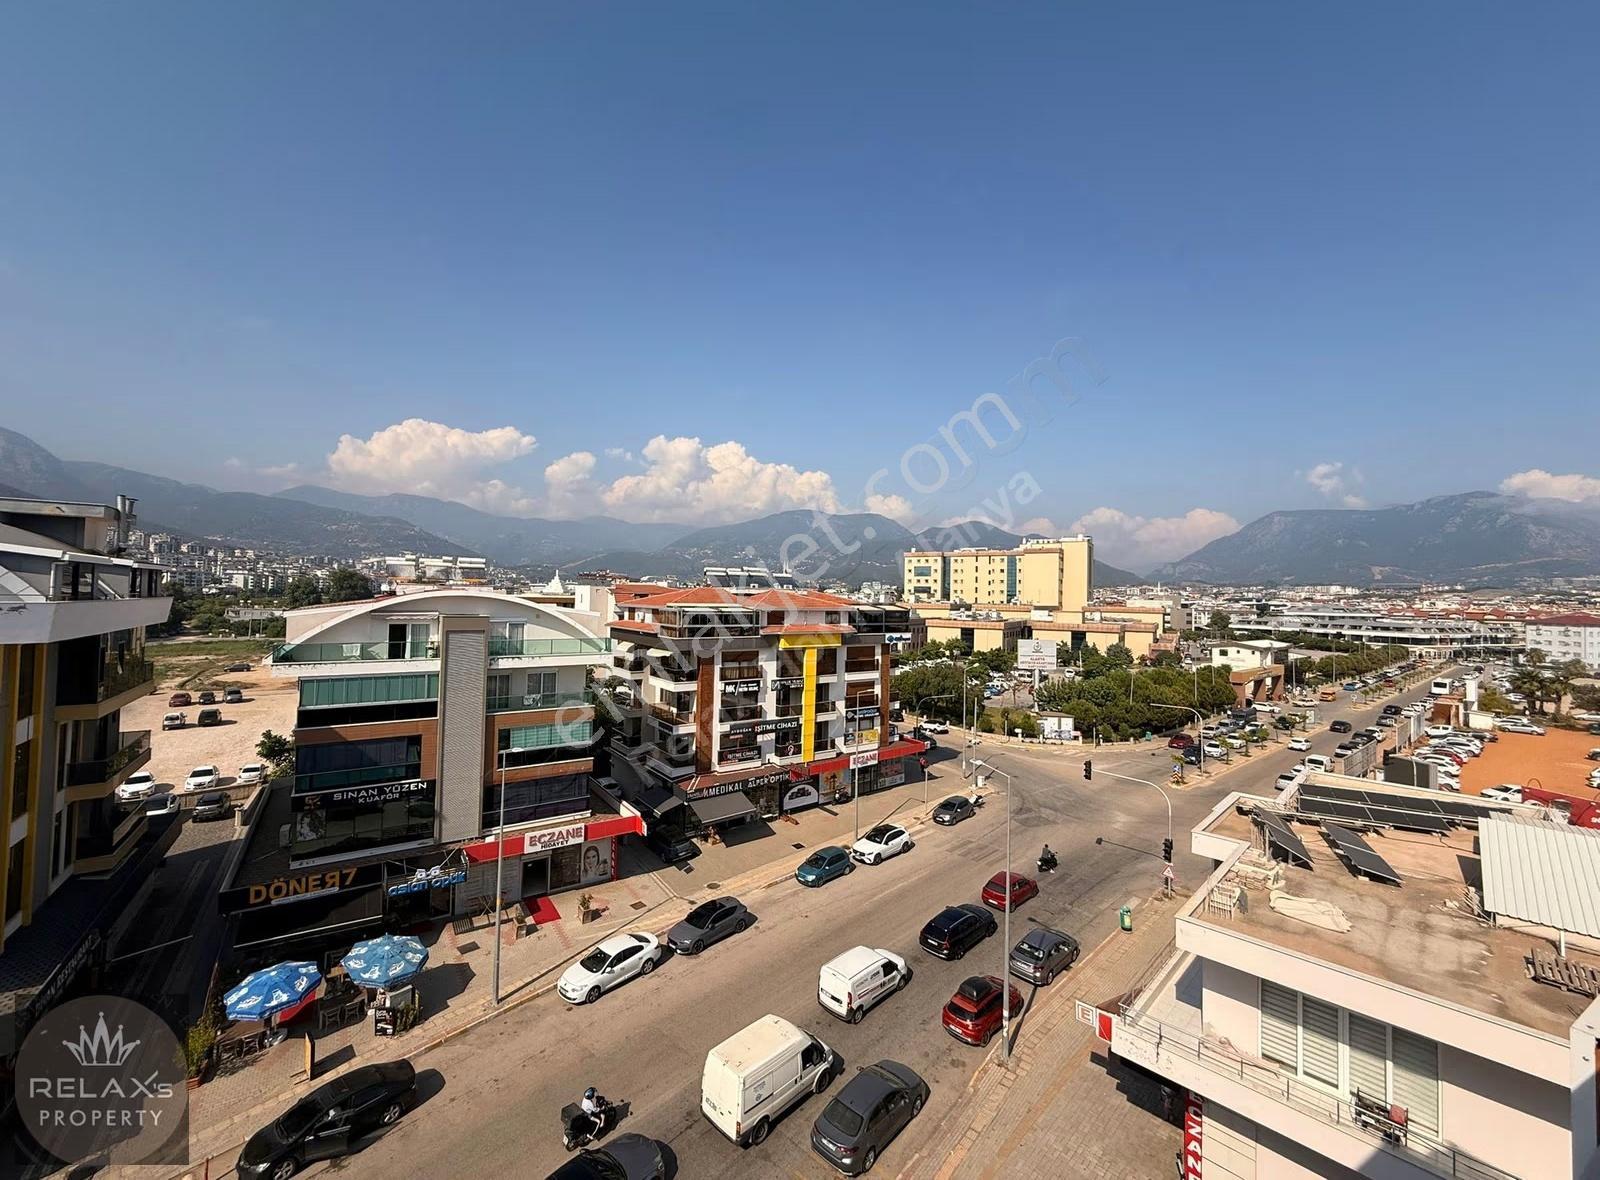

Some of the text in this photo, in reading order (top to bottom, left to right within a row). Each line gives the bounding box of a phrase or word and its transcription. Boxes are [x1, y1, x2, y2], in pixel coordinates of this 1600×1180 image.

[384, 782, 428, 794] YÜZEN
[708, 783, 744, 797] MEDİKAL
[358, 793, 400, 804] KUAFÖR
[529, 827, 583, 846] ECZANE
[388, 880, 428, 897] asian
